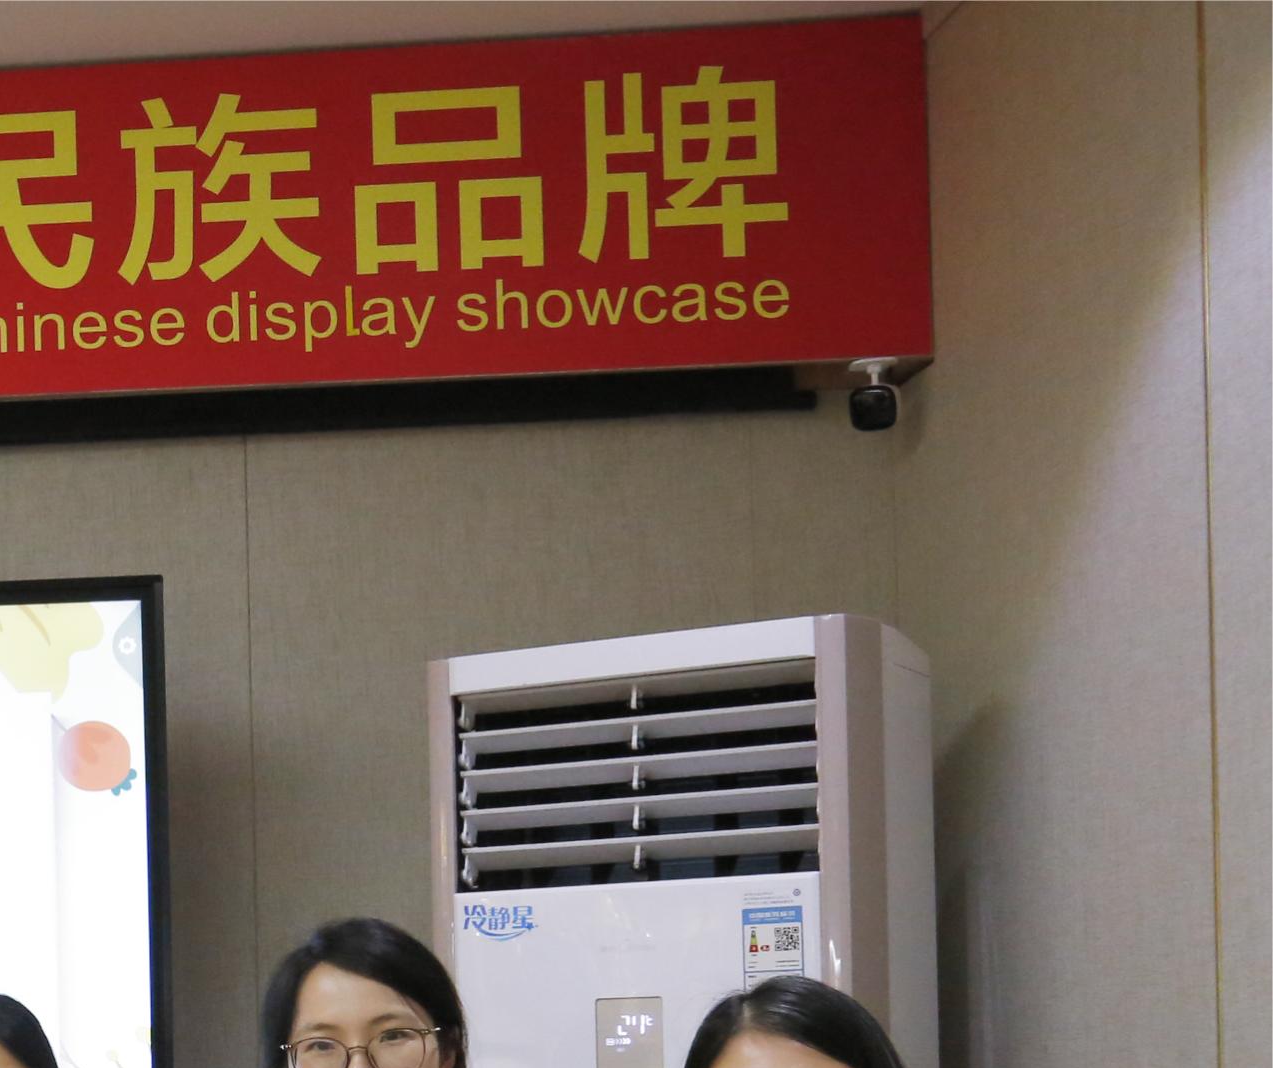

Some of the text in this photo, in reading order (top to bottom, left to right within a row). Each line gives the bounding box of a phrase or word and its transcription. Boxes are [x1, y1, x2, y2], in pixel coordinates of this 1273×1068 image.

[206, 286, 435, 352] display
[457, 279, 789, 332] showcase
[463, 904, 536, 931] 冷静星
